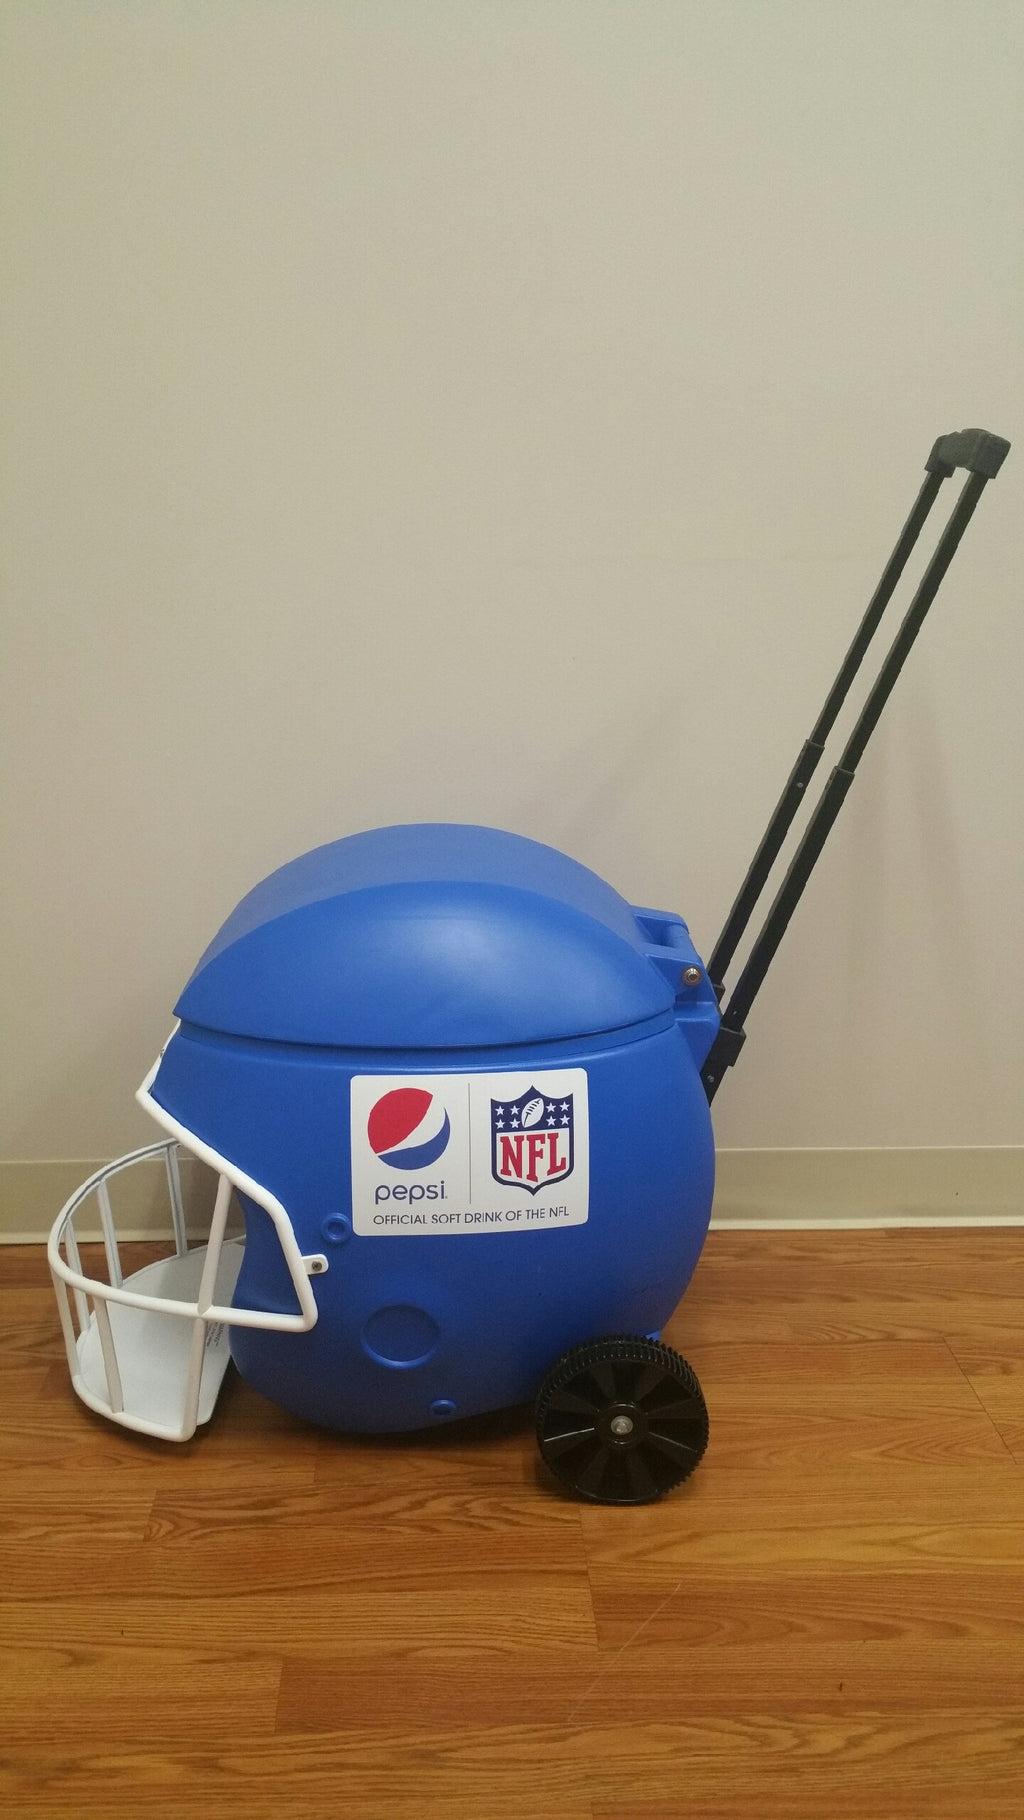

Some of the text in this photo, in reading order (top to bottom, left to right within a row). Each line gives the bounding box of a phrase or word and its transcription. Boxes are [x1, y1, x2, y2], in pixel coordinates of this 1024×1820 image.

[500, 1132, 566, 1182] NFL
[375, 1180, 446, 1204] pepsi
[373, 1206, 569, 1225] OFFICIAL SOFT DRINK OF THE NFL
